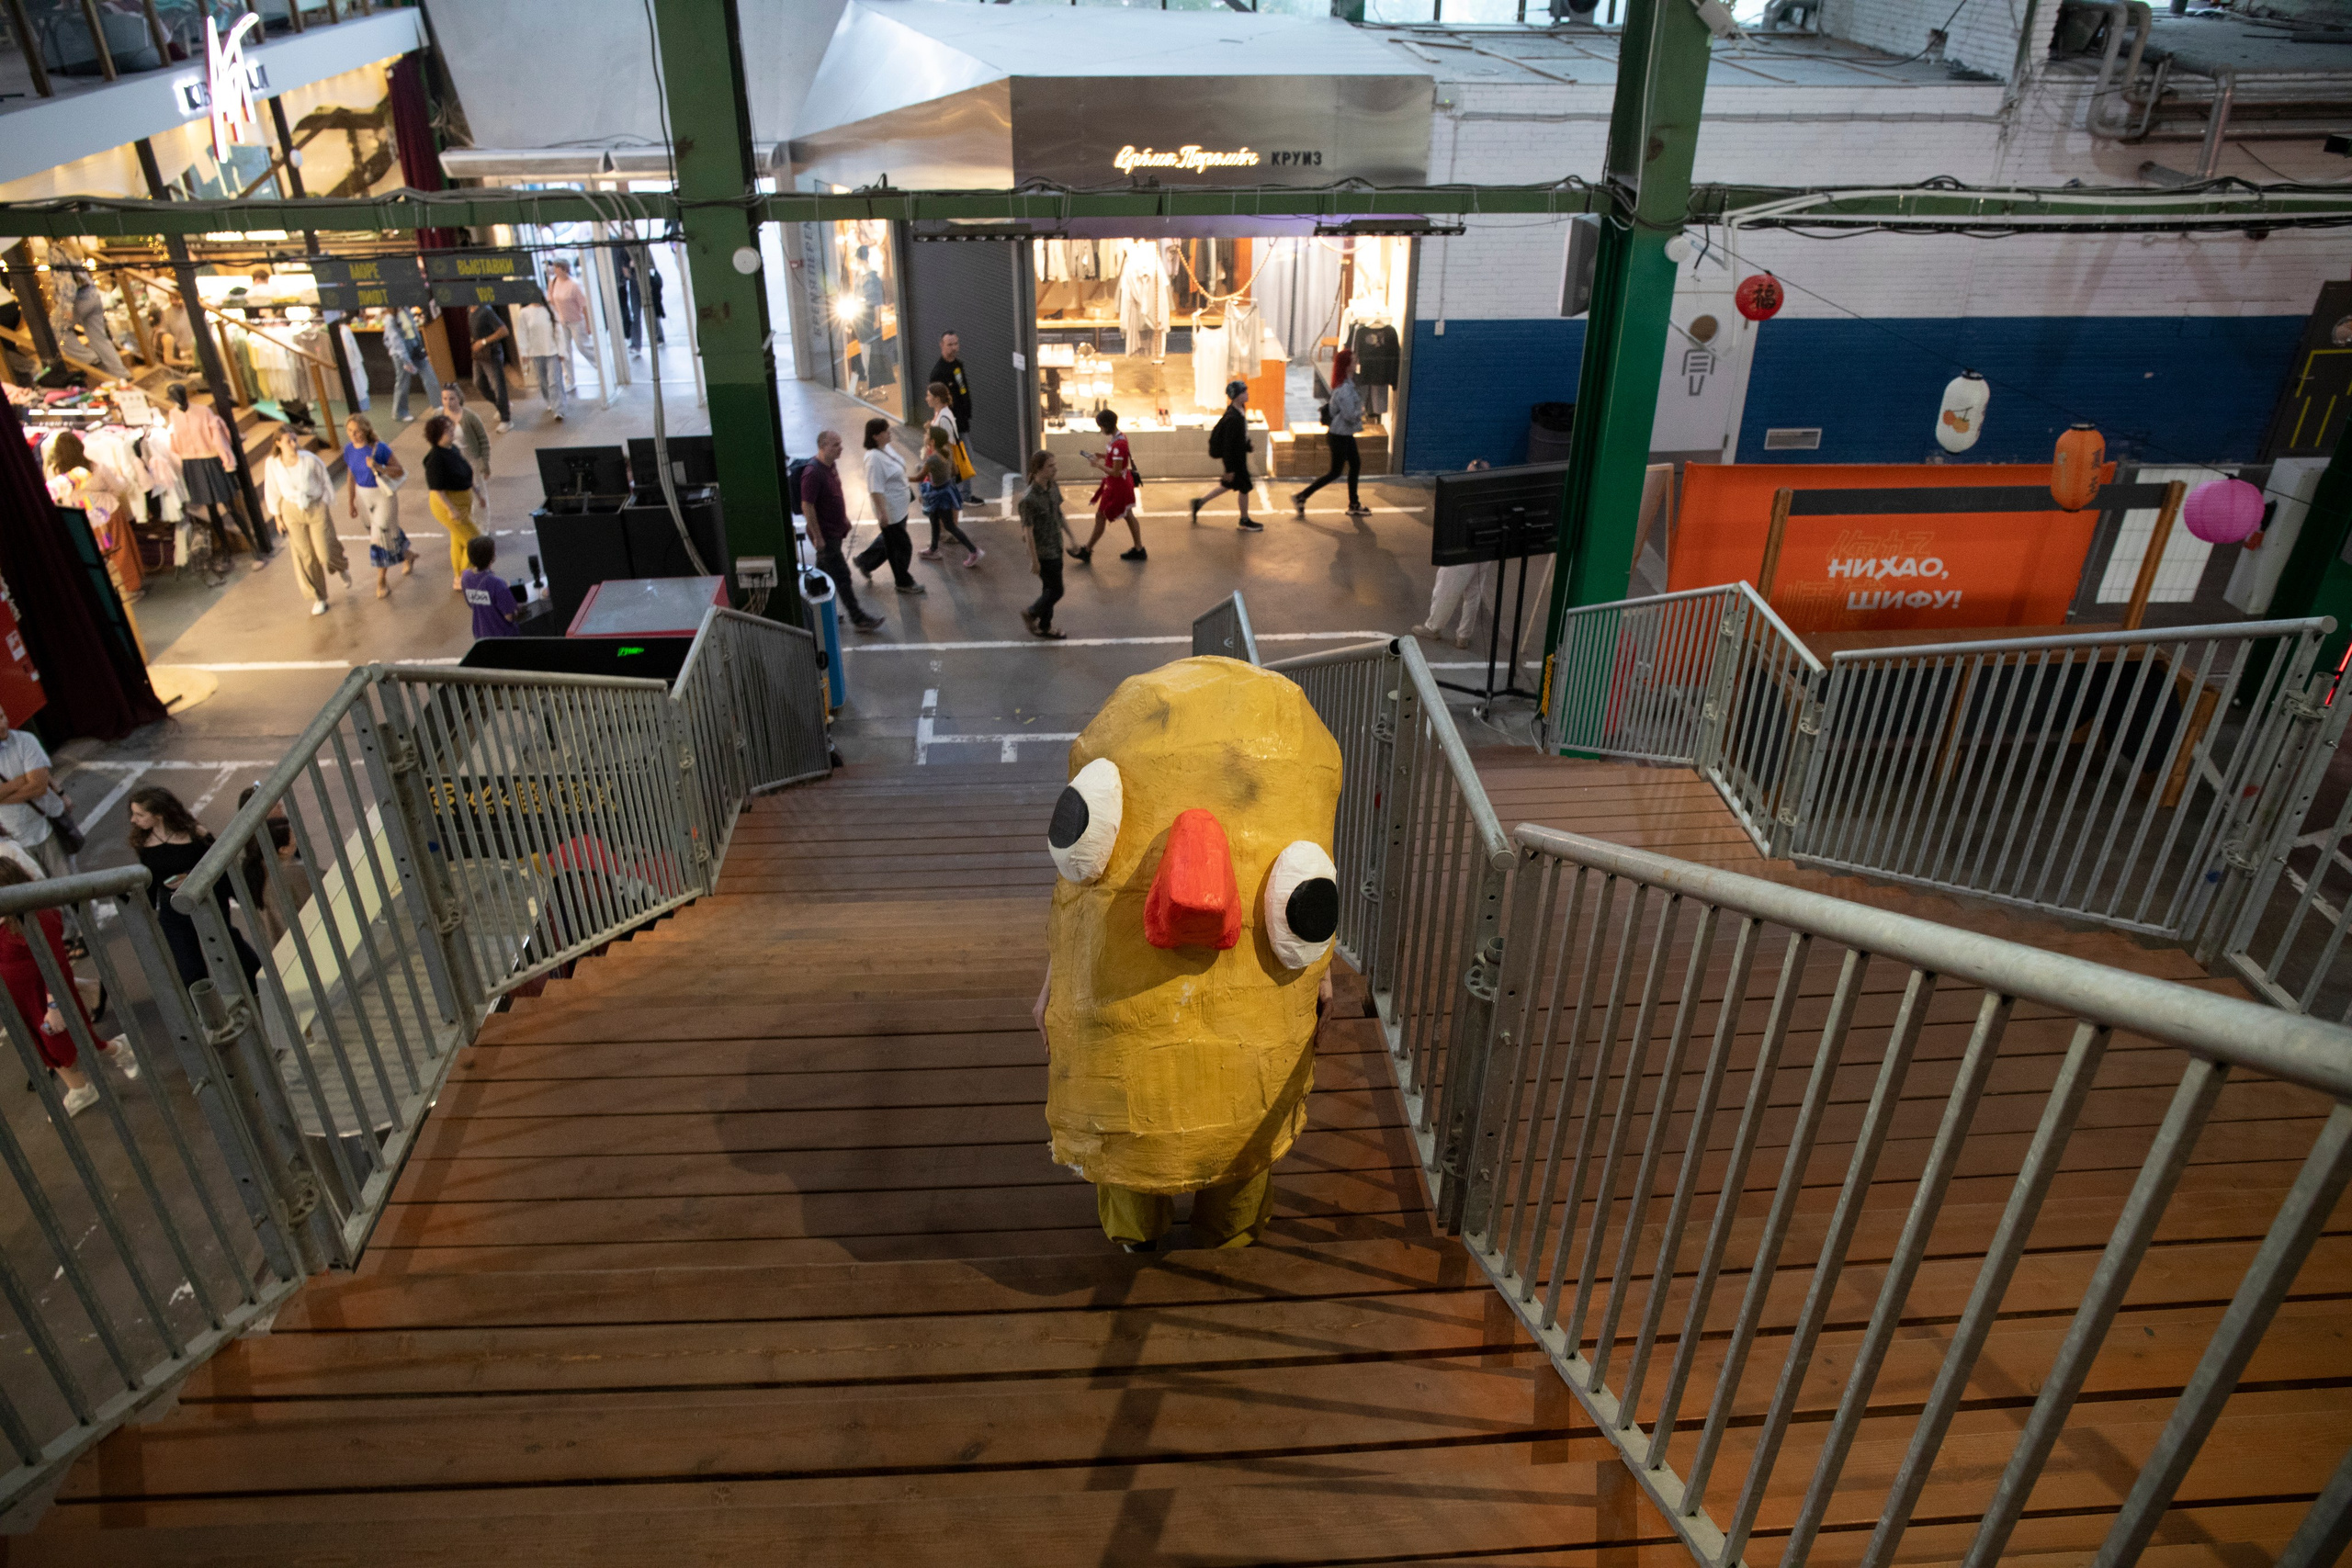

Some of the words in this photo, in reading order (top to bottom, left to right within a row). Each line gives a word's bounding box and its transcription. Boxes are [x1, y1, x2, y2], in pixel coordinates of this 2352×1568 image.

[1272, 151, 1322, 166] КРУИЗ
[348, 263, 380, 279] МОРЕ
[457, 258, 514, 275] ВЫСТАВКИ
[357, 289, 389, 306] ЛИФТ
[476, 287, 495, 302] WC
[1753, 284, 1777, 310] 福
[1827, 556, 1949, 581] НИХАО,
[1846, 590, 1962, 610] ШИФУ!
